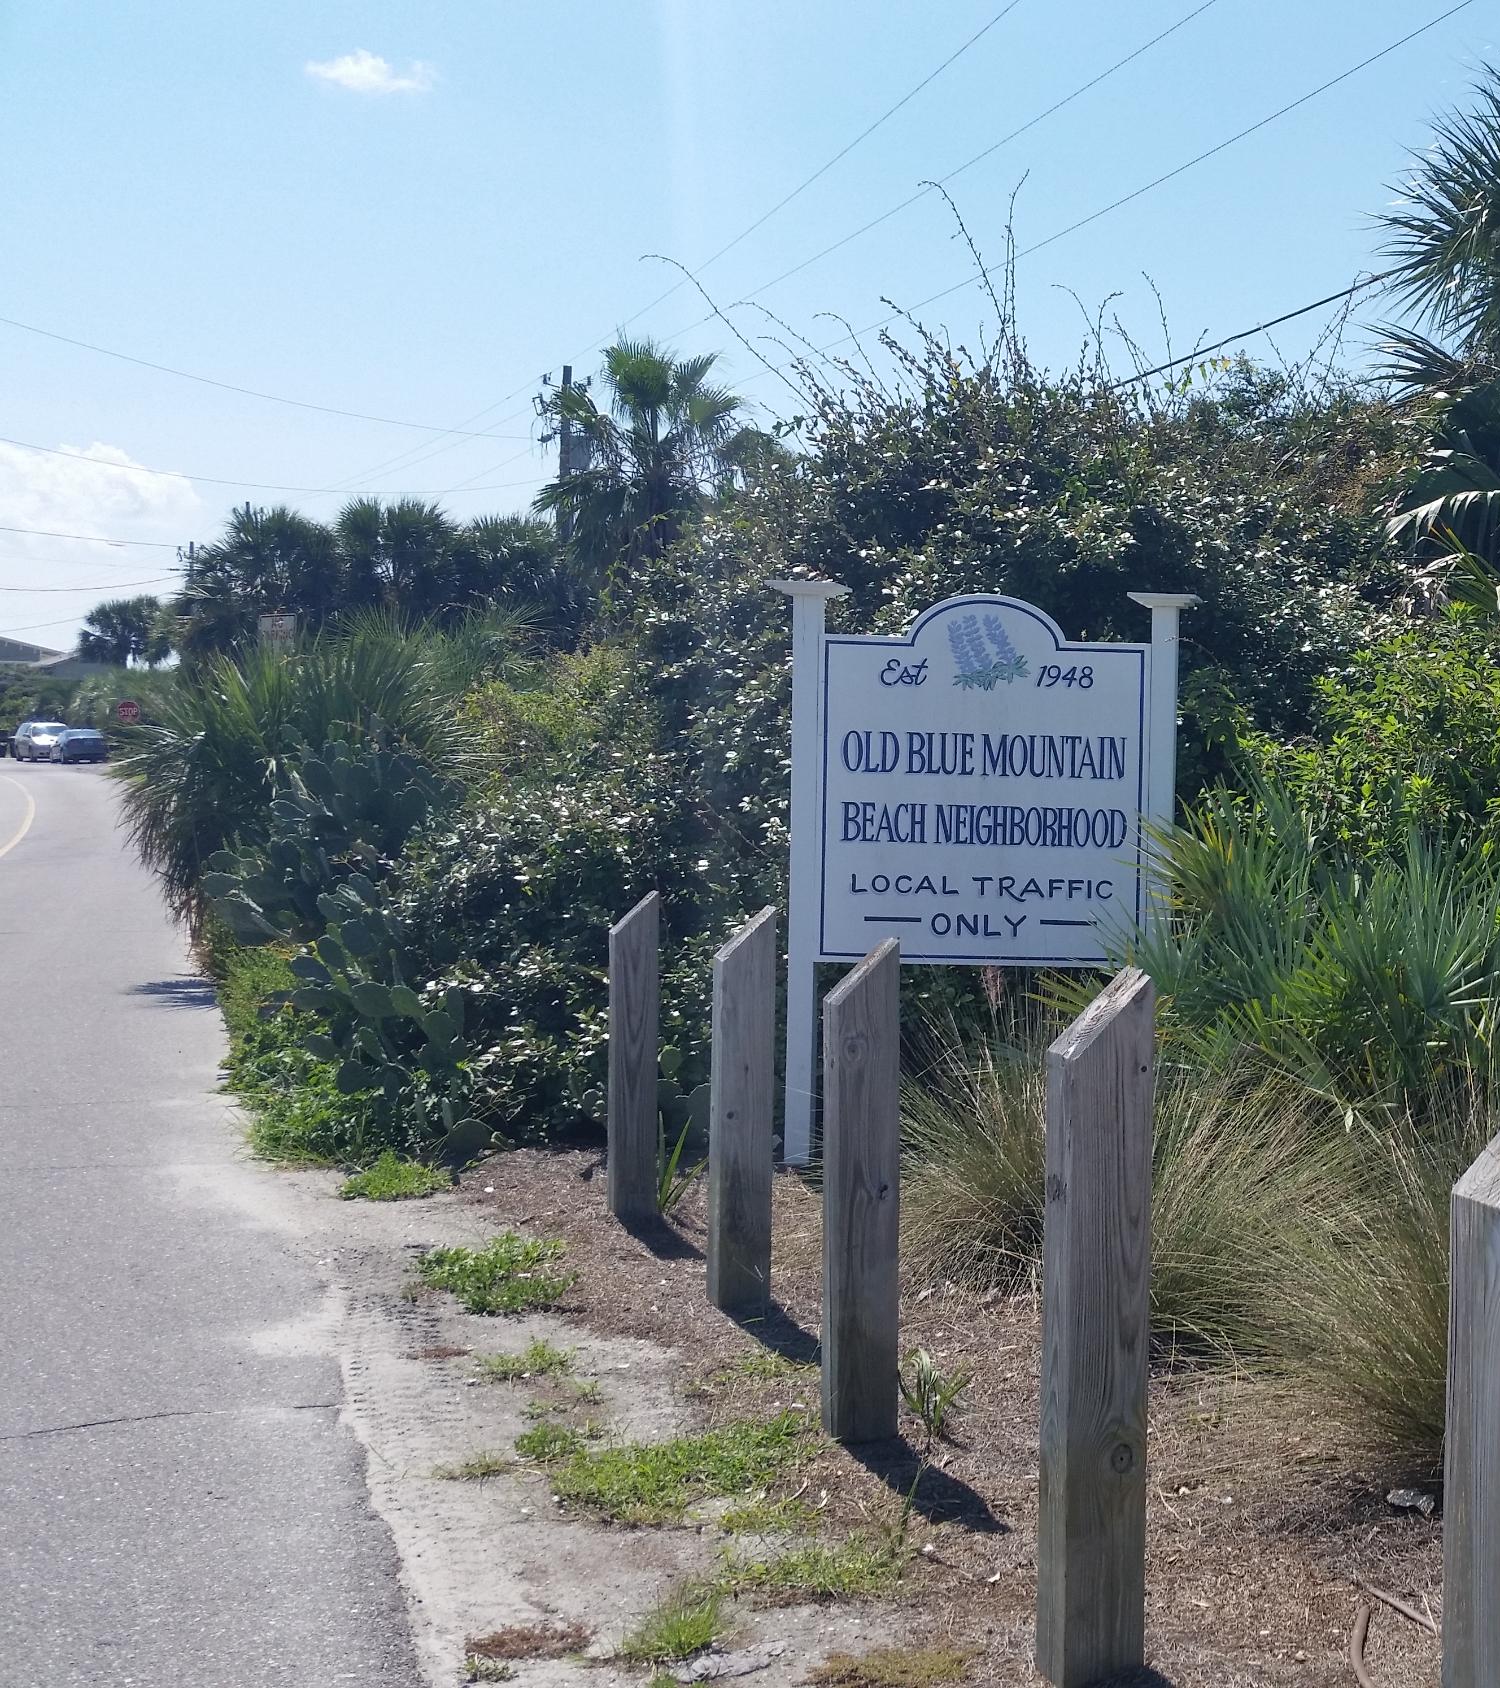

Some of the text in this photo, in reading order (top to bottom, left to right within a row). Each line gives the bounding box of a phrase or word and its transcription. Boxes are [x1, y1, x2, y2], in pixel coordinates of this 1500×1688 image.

[263, 629, 295, 641] ARKING
[880, 657, 1094, 689] Est 1948
[119, 707, 138, 716] STOP
[843, 730, 1127, 780] OLD BLUE MOUNTAIN
[841, 801, 1128, 849] BEACH NEIGHBORHOOD
[851, 873, 1113, 902] LOCAL TRAFFIC
[931, 912, 1027, 937] ONLY
